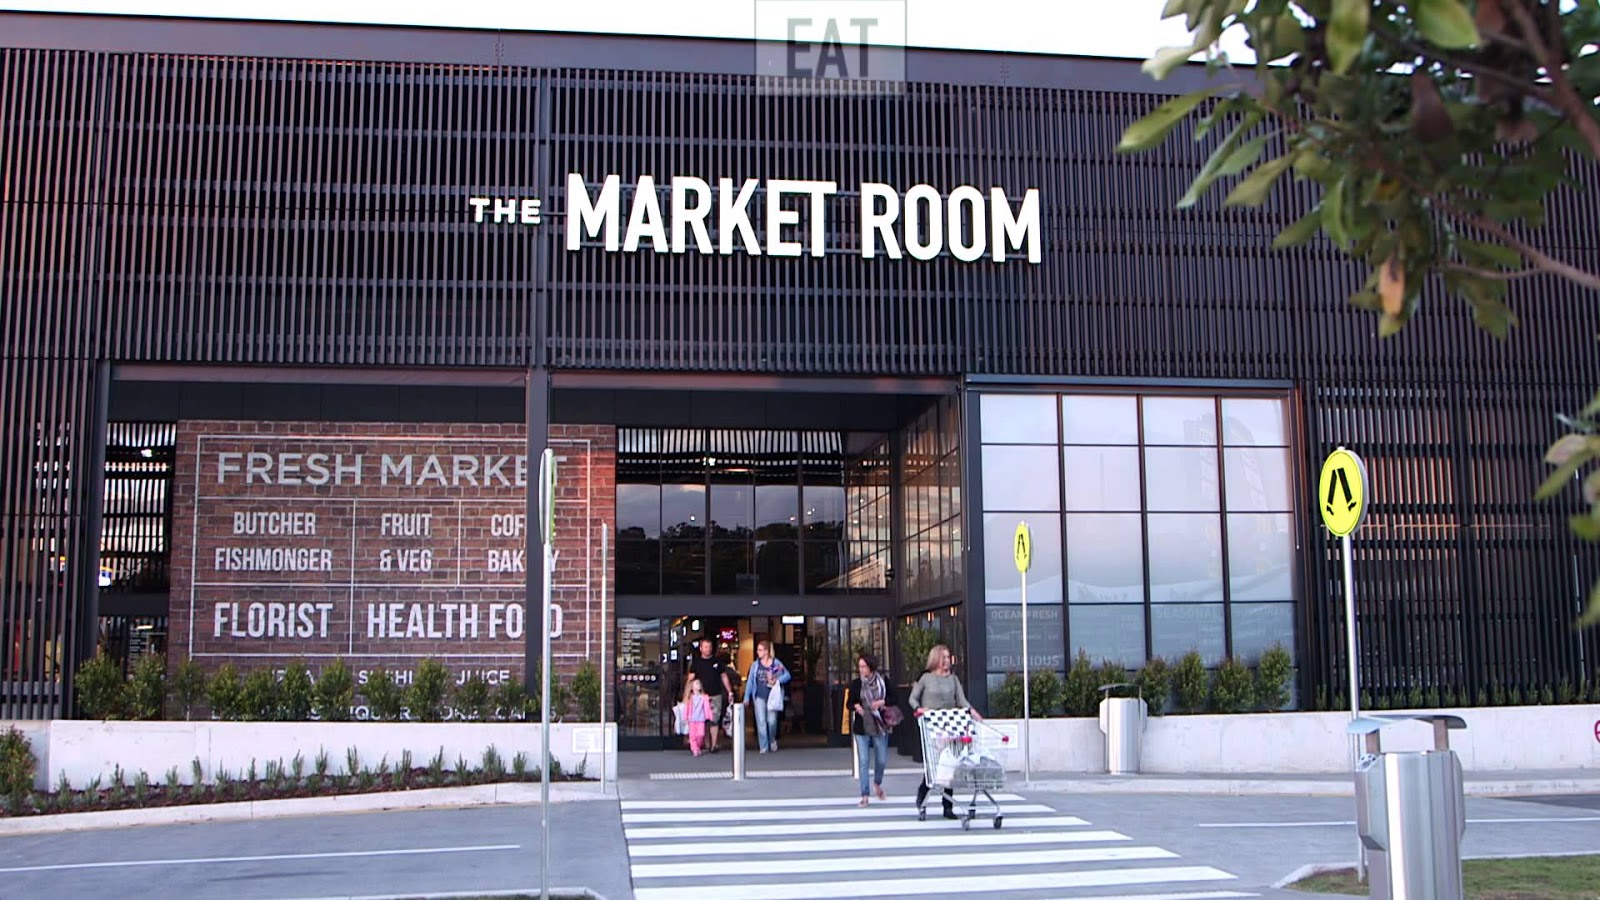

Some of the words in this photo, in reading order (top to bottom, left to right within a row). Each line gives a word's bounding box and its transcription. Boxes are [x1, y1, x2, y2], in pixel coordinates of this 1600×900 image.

[469, 197, 542, 225] THE
[565, 172, 838, 258] MARKET
[860, 181, 1042, 264] ROOM
[217, 452, 362, 486] FRESH
[233, 511, 317, 535] BUTCHER
[381, 513, 432, 536] FRUIT
[214, 547, 333, 572] FISHMONGER
[379, 549, 392, 573] &
[396, 549, 432, 573] VEG
[487, 550, 560, 573] BAKY
[213, 602, 334, 638] FLORIST
[366, 602, 479, 638] HEALTH
[488, 603, 563, 639] FOD
[991, 655, 1060, 668] DELIIOUS
[358, 669, 413, 685] SSHI
